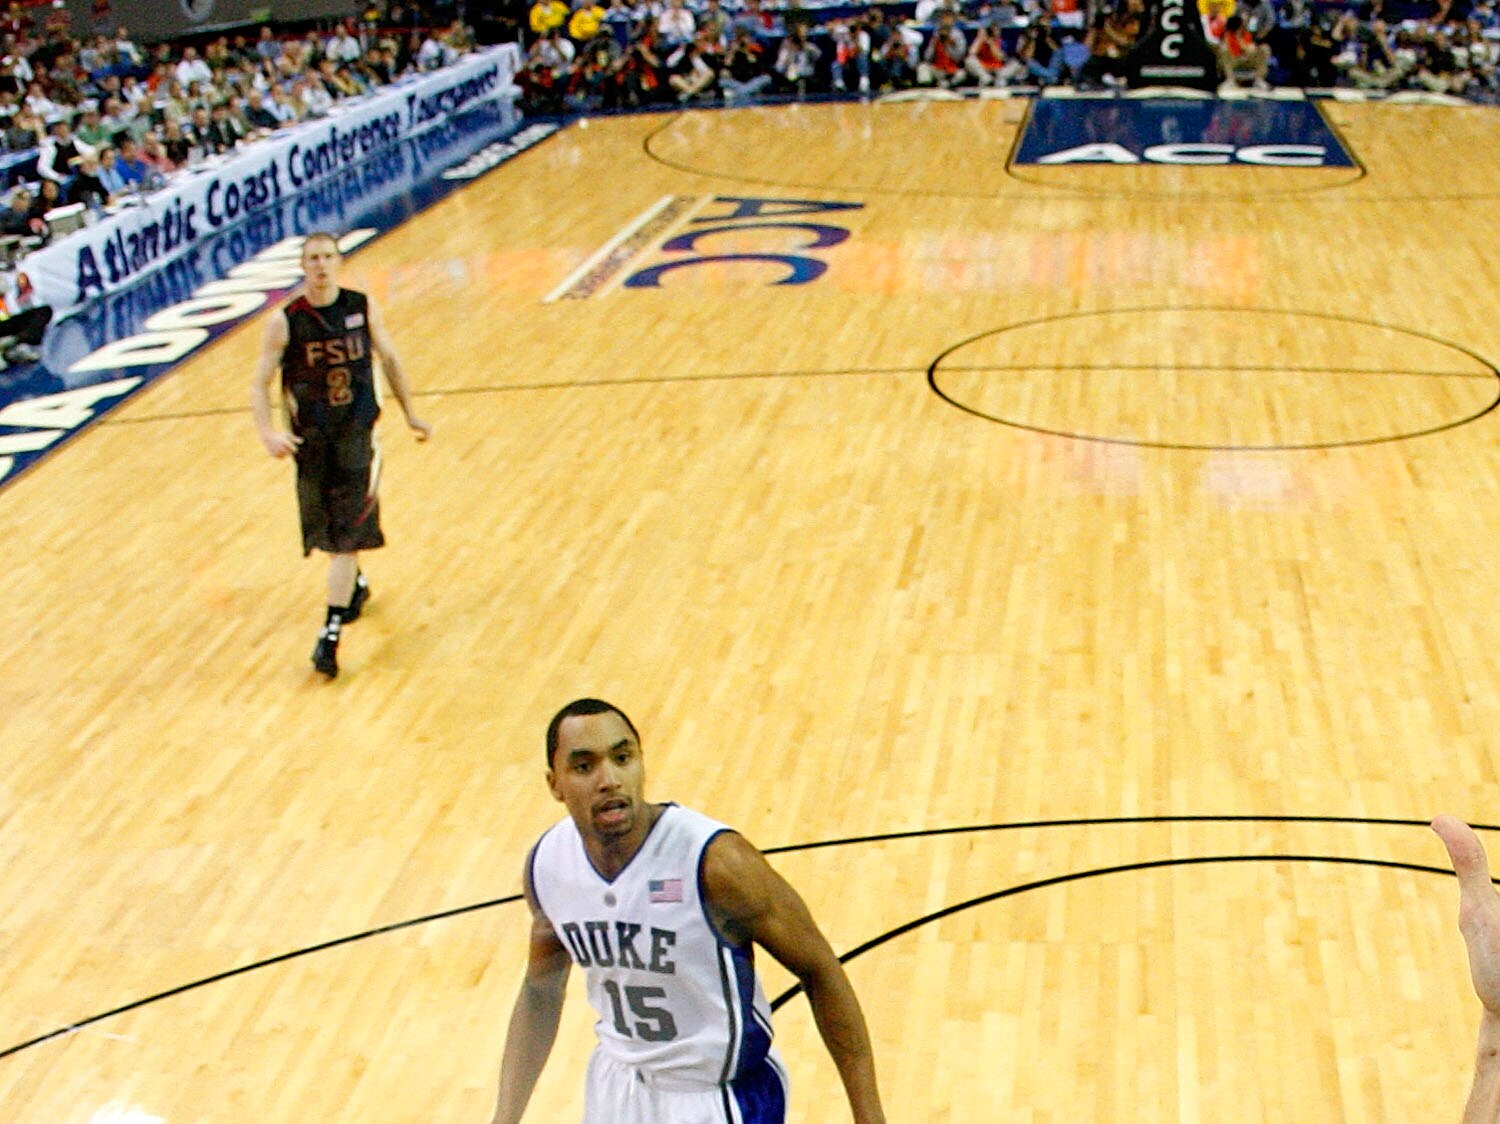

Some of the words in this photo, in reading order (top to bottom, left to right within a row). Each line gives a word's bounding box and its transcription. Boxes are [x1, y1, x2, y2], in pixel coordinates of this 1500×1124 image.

[1037, 143, 1326, 165] ACC
[75, 197, 197, 301] Atlantic
[206, 162, 282, 227] Coast
[287, 111, 401, 186] Conference
[624, 196, 865, 288] ACC
[304, 336, 364, 367] FSU
[561, 920, 677, 975] DUKE
[601, 979, 678, 1042] 15
